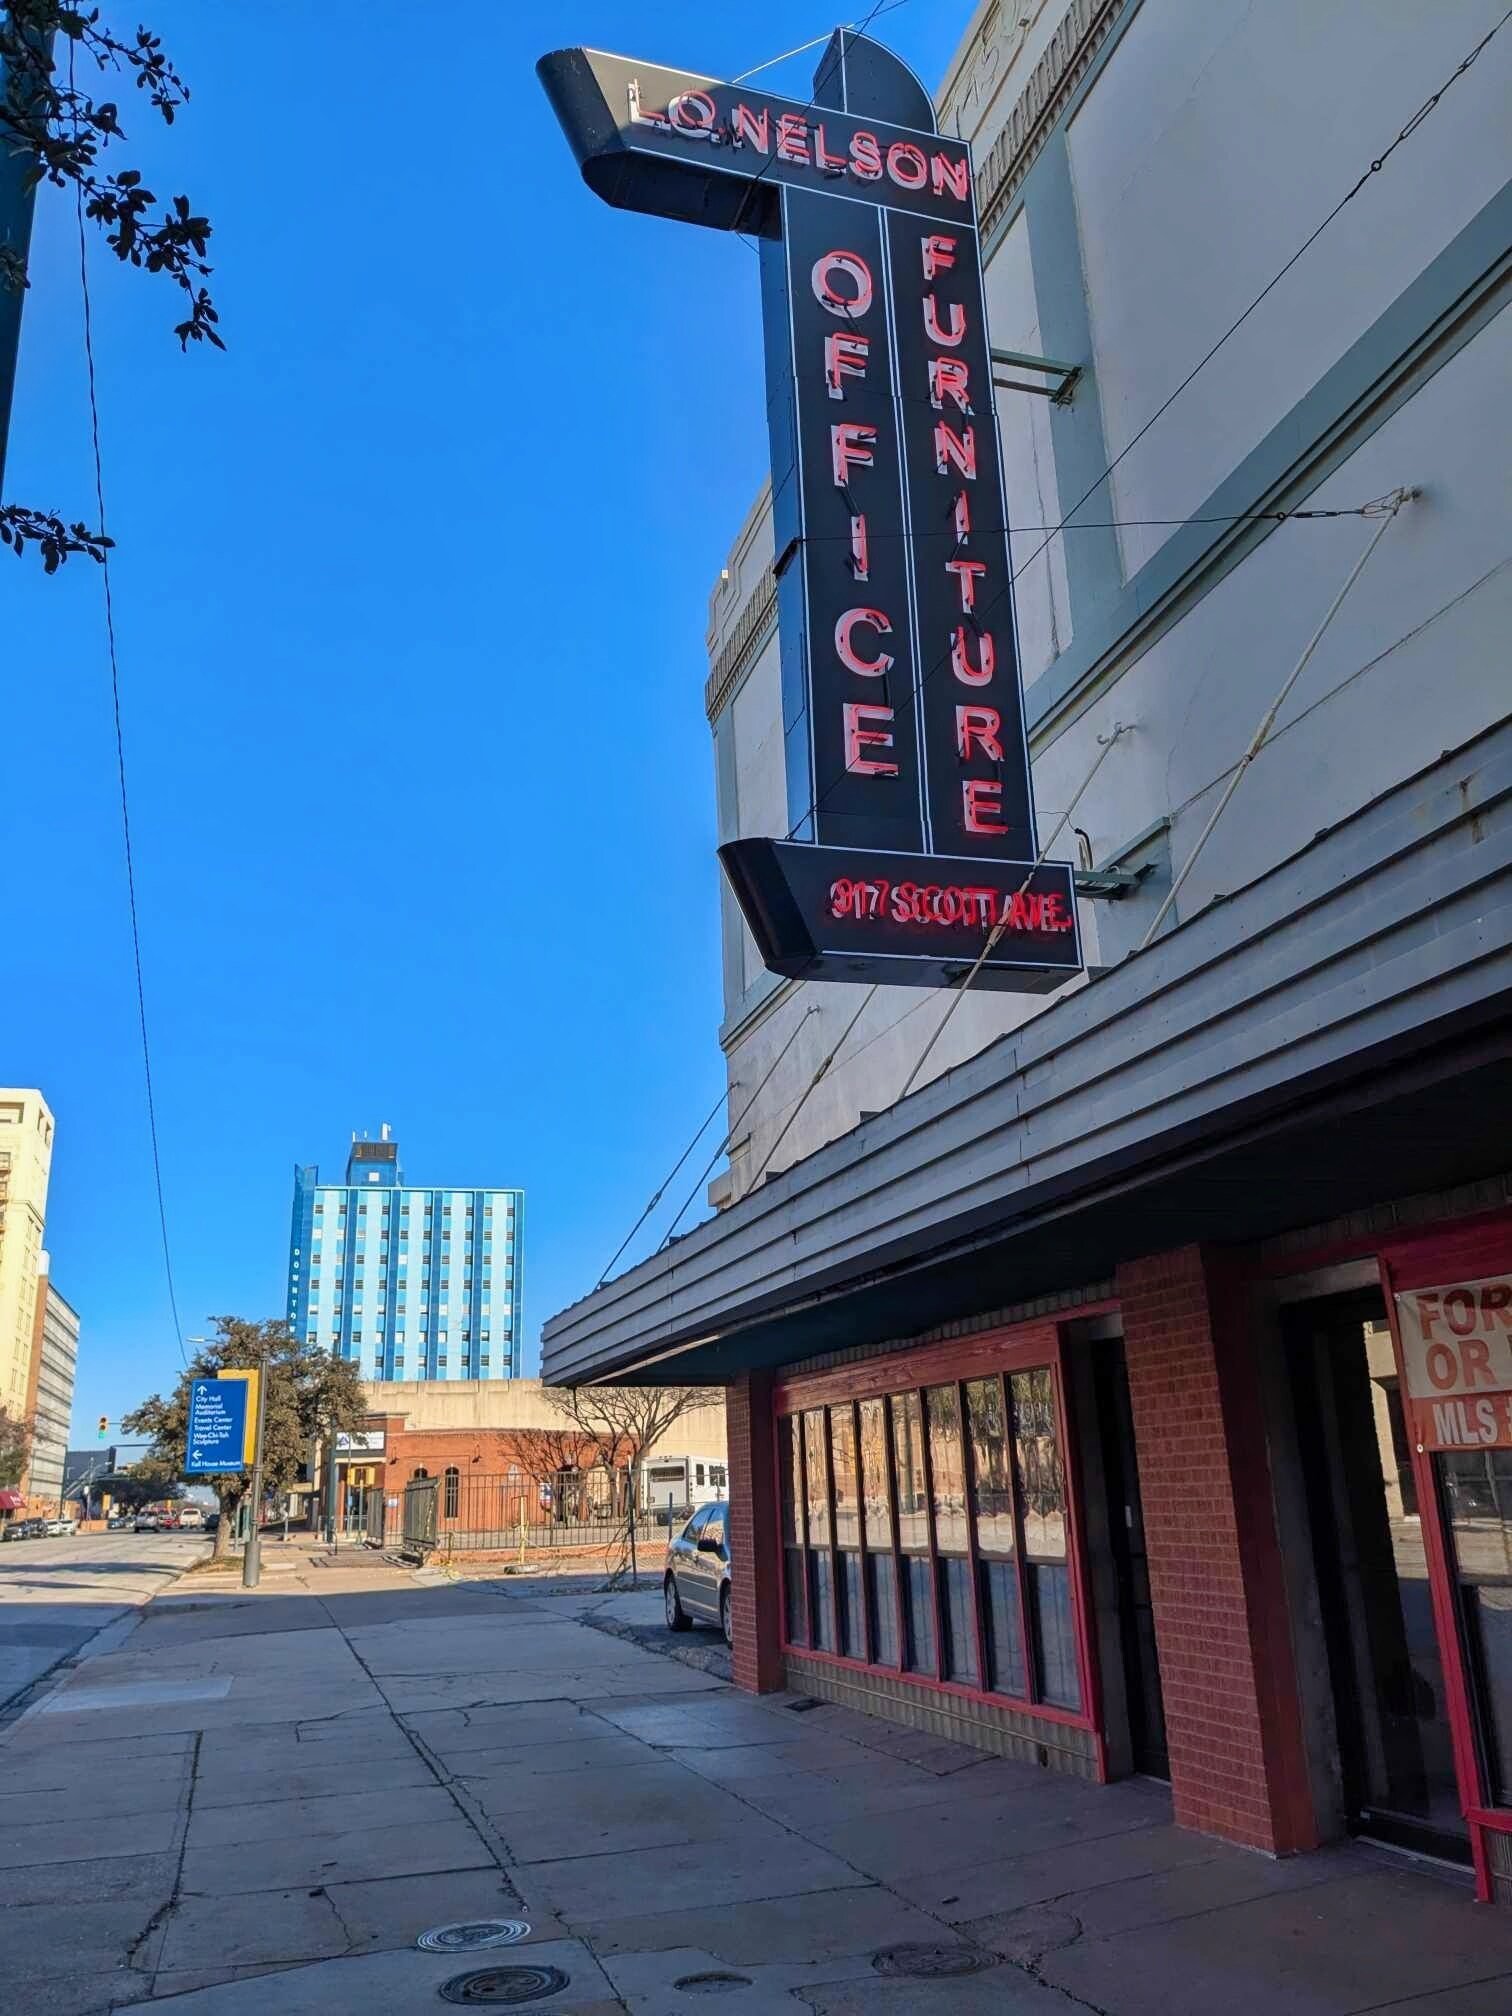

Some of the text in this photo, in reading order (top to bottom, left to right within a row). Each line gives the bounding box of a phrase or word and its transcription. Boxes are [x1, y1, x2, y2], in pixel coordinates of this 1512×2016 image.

[731, 103, 967, 201] NELSON
[811, 250, 899, 777] OFFICE
[920, 235, 1008, 834] FURNITURE
[830, 878, 889, 920] 917
[891, 881, 999, 928] SCOTT
[1416, 1283, 1512, 1340] FOR
[1425, 1339, 1497, 1390] OR
[195, 1395, 208, 1403] City
[1432, 1399, 1499, 1446] MLS
[193, 1438, 219, 1446] Sculpture
